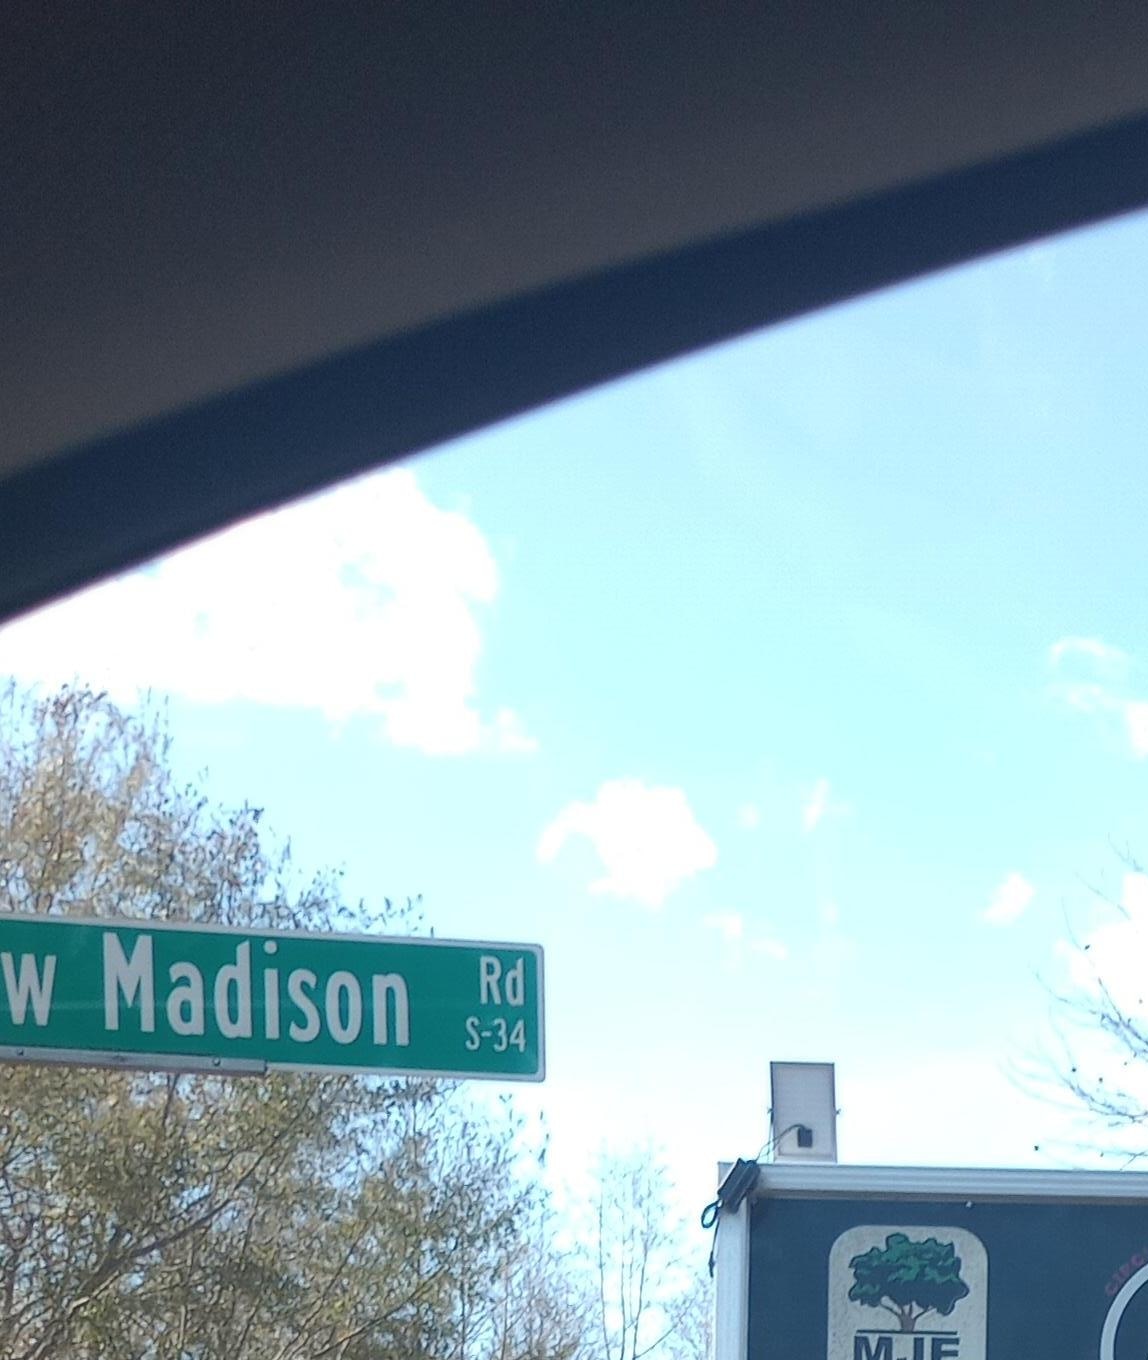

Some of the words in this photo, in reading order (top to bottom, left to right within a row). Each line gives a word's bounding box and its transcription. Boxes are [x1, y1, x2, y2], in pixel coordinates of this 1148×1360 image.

[103, 932, 411, 1047] Madison
[479, 955, 525, 1006] Rd
[464, 1016, 527, 1053] S-34
